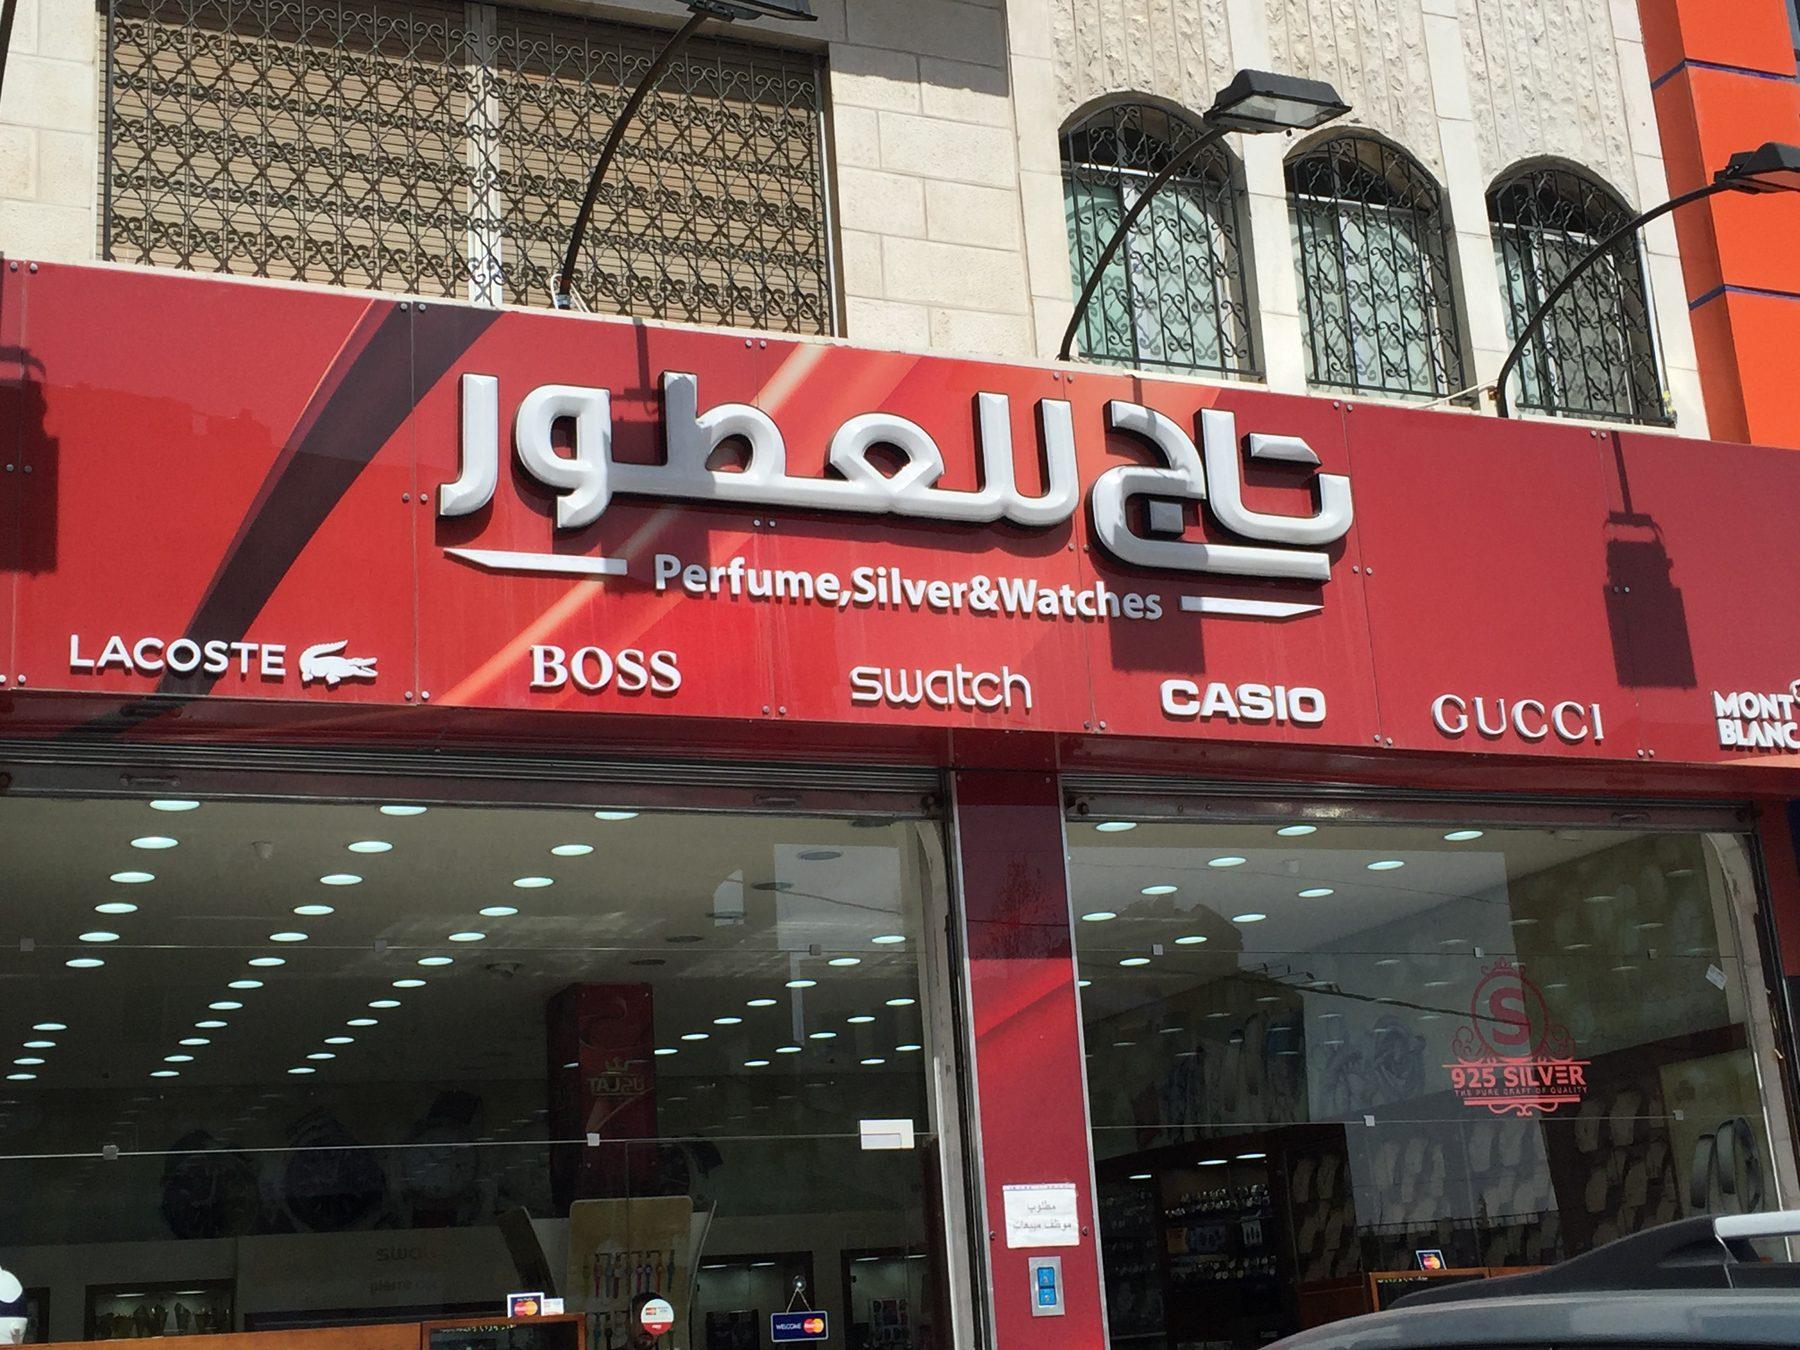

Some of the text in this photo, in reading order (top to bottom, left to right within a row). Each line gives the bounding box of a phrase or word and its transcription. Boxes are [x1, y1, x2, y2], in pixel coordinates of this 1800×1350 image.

[440, 371, 1354, 581] تاج للعطور
[654, 552, 1163, 621] Perfume,Silver&Watches
[69, 634, 287, 676] LACOSTE
[530, 644, 682, 692] BOSS
[850, 662, 1033, 709] swatch
[1160, 678, 1327, 723] CASIO
[1713, 690, 1794, 720] MONT
[1431, 693, 1605, 742] GUCCI
[1717, 718, 1800, 749] BLANC
[1451, 1065, 1587, 1088] 925 SILVER
[1550, 1085, 1588, 1095] QUALITY
